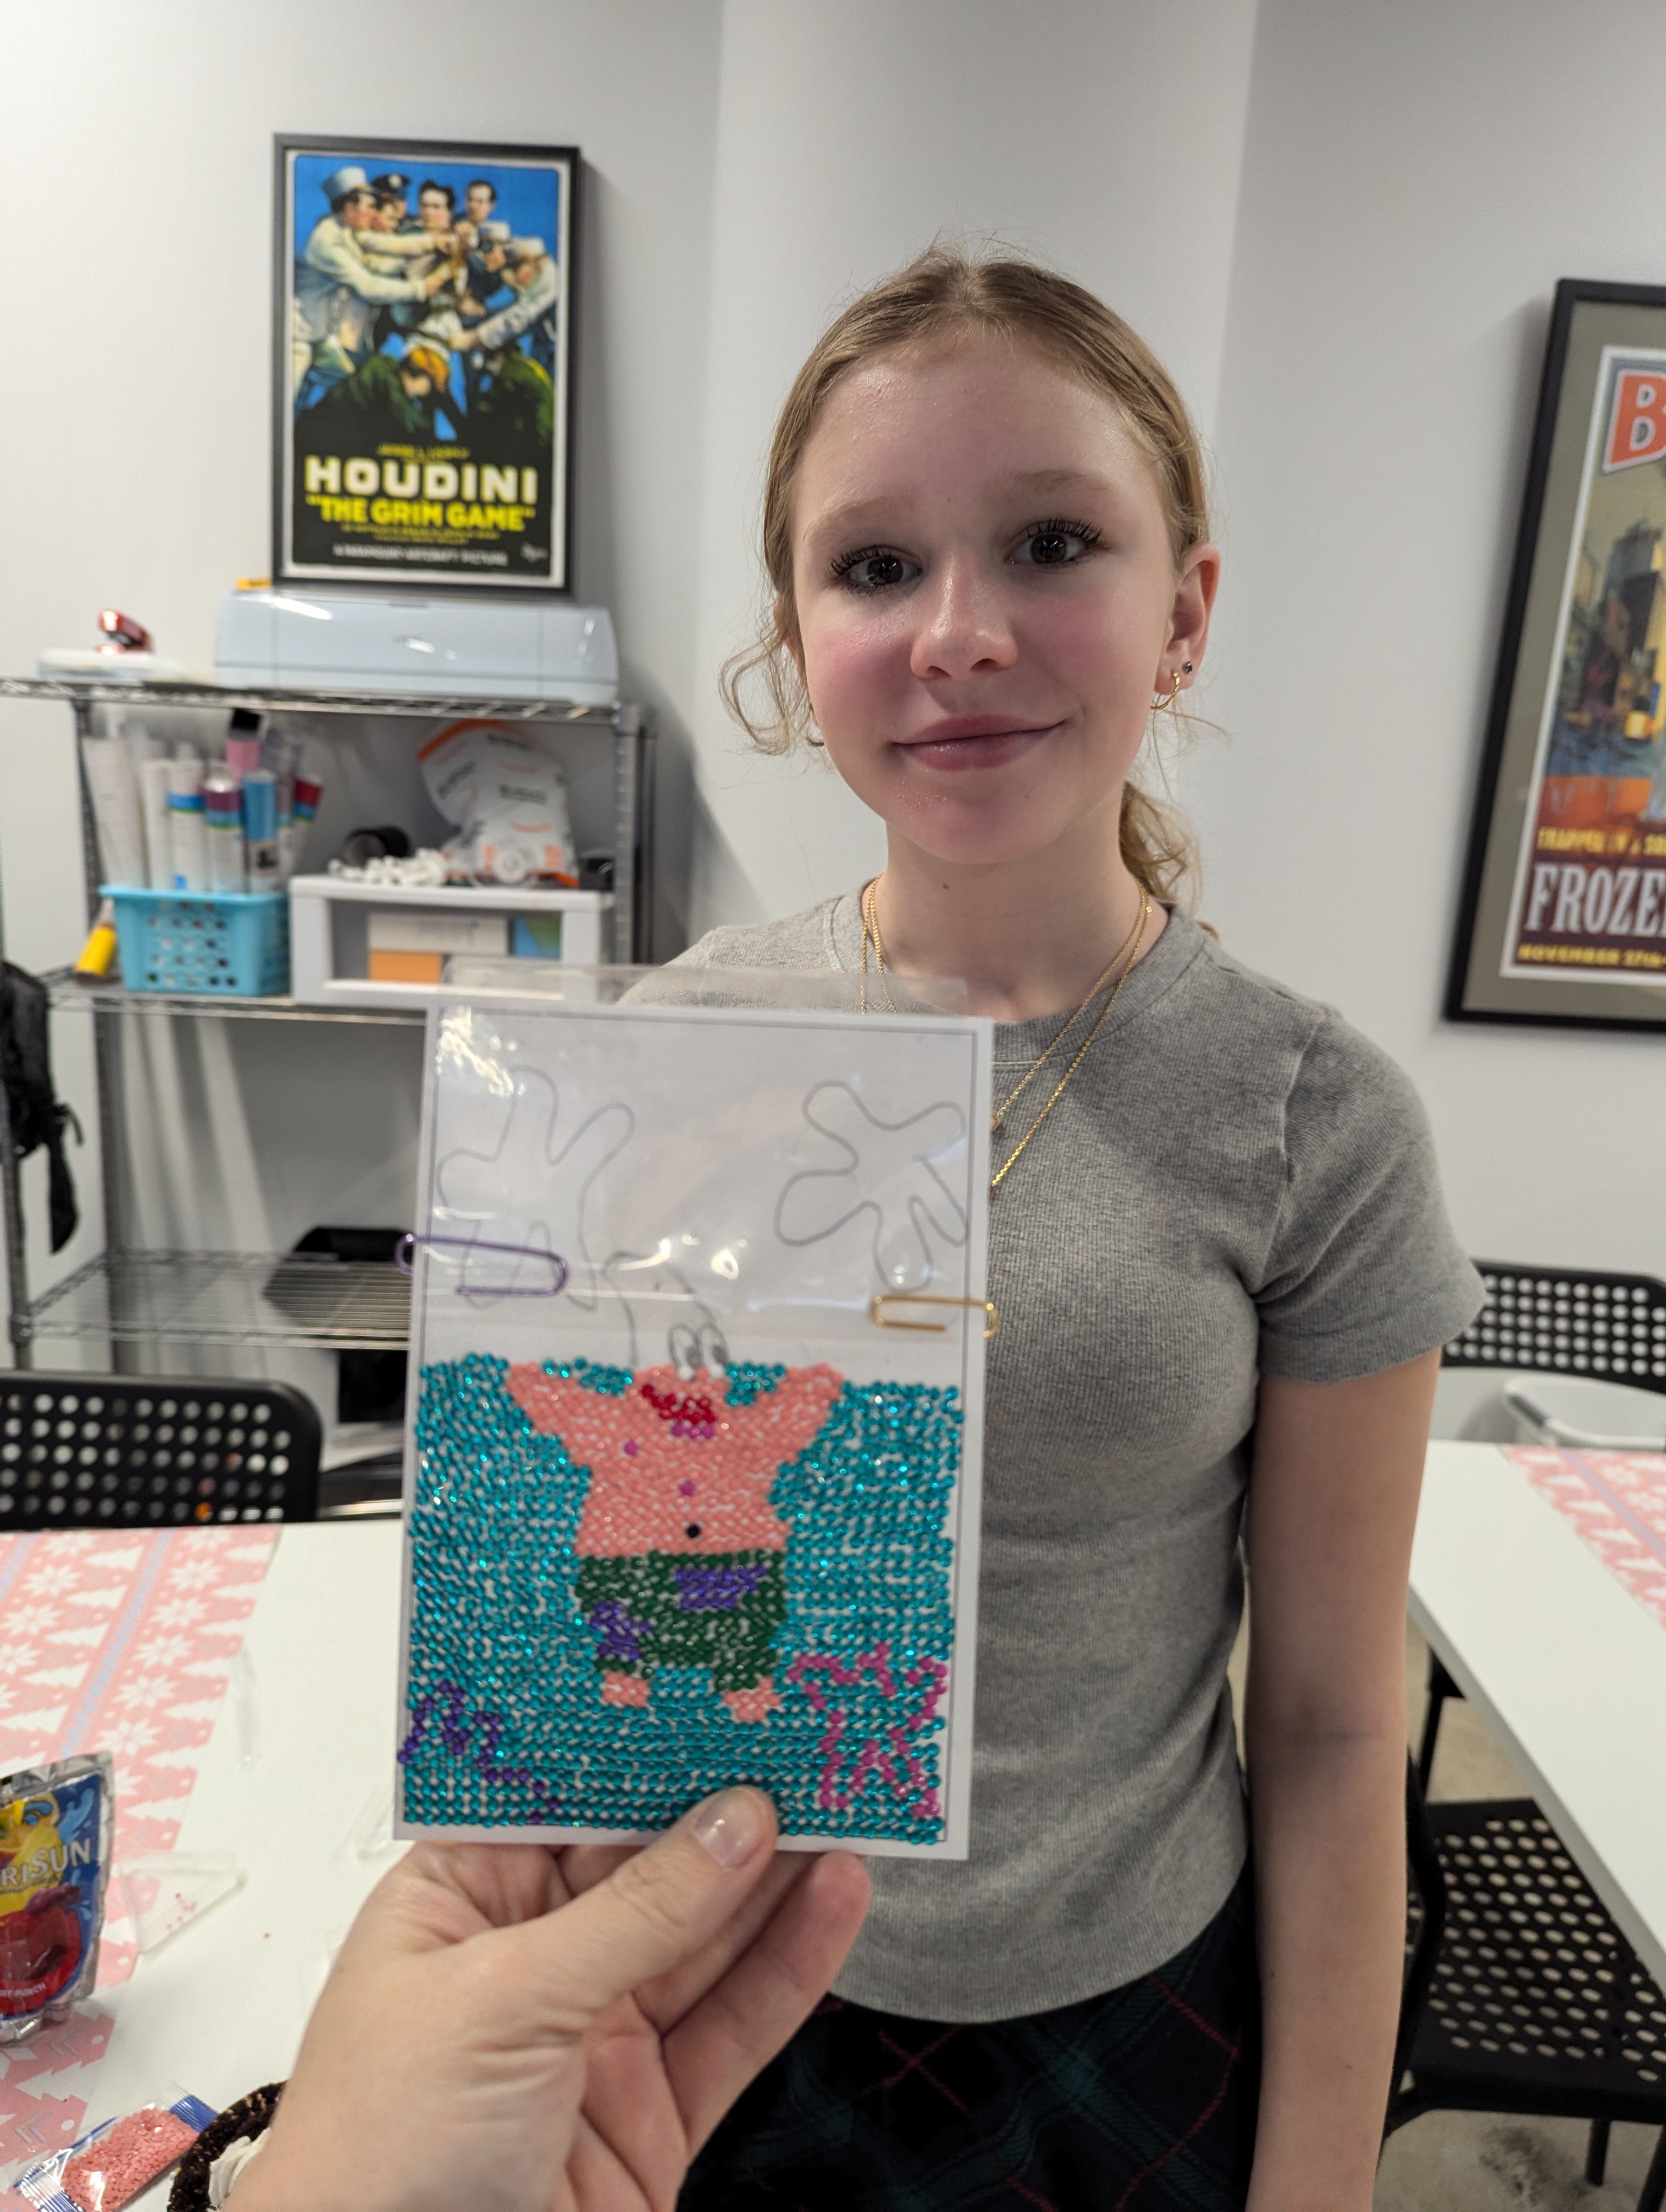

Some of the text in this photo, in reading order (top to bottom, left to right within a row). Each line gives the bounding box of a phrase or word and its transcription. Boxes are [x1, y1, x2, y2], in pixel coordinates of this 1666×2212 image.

[304, 455, 537, 505] HOUDINI
[370, 497, 443, 526] GRIM
[1524, 863, 1666, 938] FROZE
[1518, 944, 1620, 965] NOVEMBER
